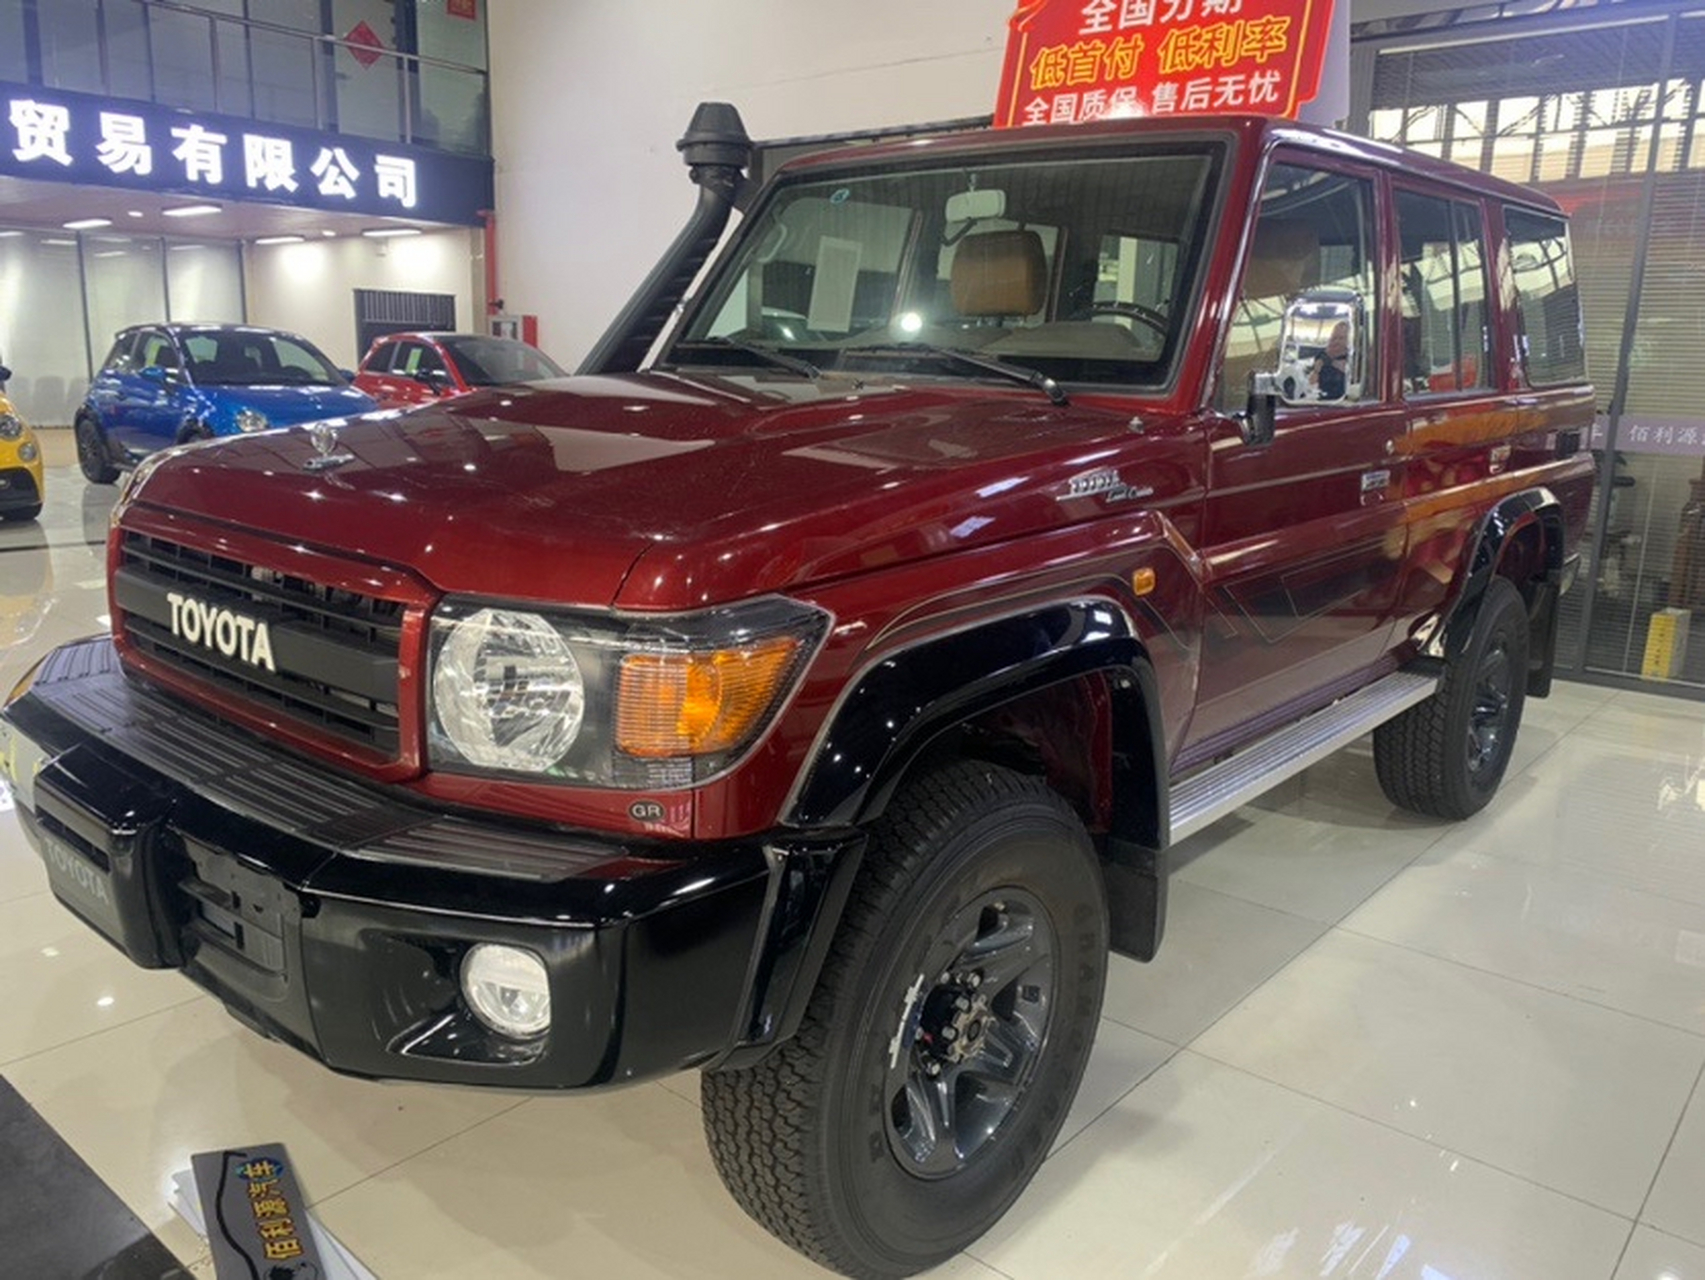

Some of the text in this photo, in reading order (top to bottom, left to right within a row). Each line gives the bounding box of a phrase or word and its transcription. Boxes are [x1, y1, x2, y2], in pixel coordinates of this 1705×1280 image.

[1030, 15, 1291, 90] 低首付 低利率
[1151, 70, 1281, 114] 售后无忧
[9, 98, 418, 209] 贸易有限公司
[166, 592, 276, 672] TOYOTA
[631, 803, 661, 819] GR
[44, 837, 109, 906] TOYOTA
